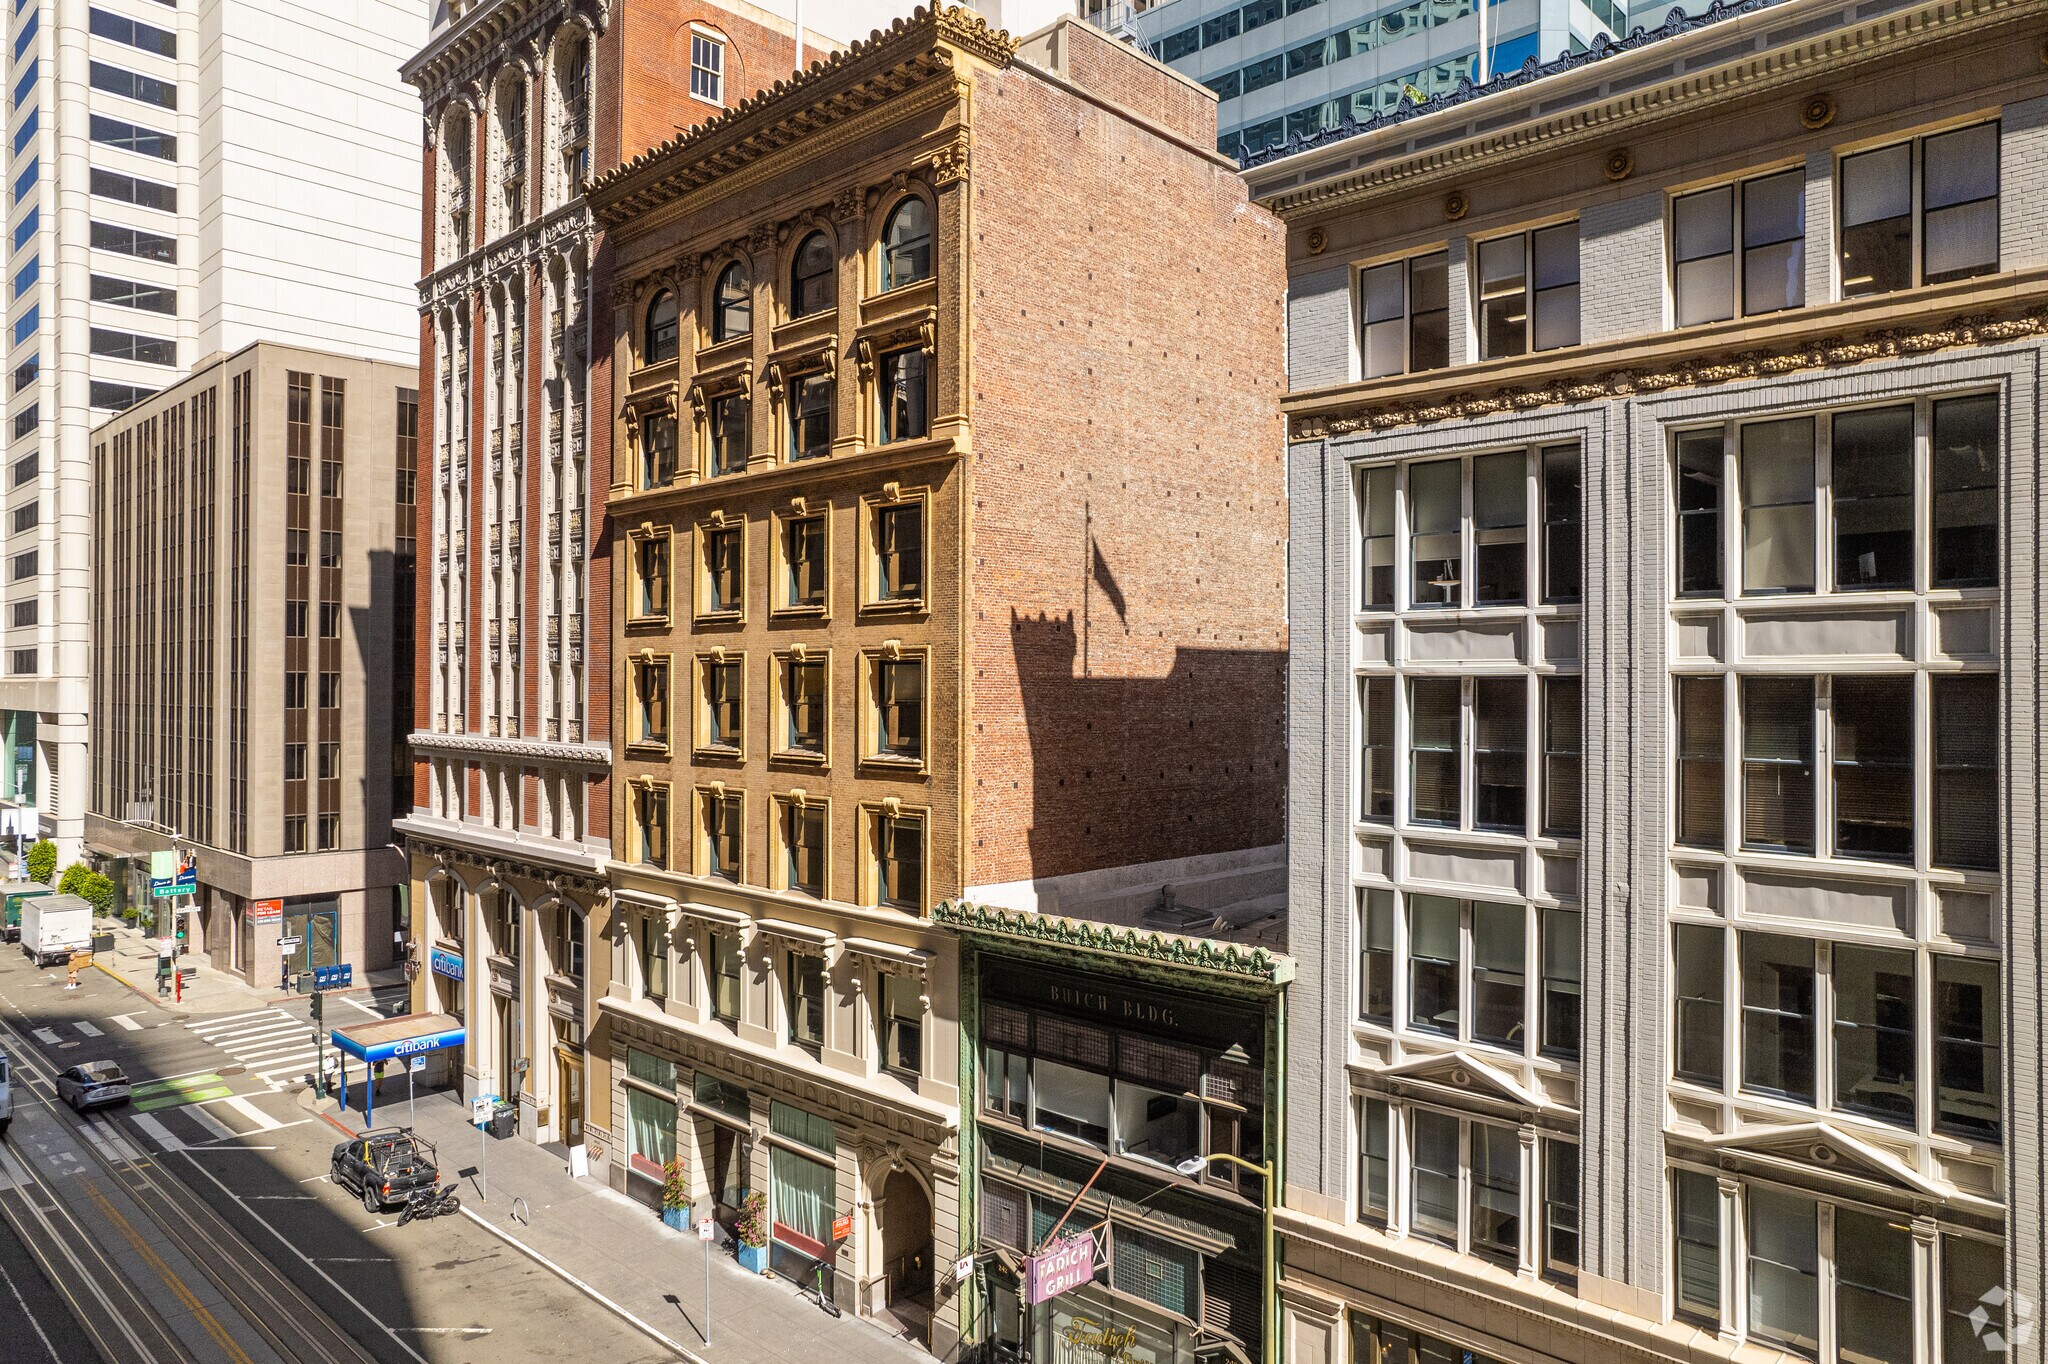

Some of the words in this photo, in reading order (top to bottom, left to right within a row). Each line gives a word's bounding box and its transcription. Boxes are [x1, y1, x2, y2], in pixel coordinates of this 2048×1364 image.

[159, 887, 190, 895] Battery
[434, 955, 464, 978] citibank
[1123, 1000, 1179, 1027] BLDG.
[393, 1037, 440, 1055] citibank
[1040, 1245, 1088, 1279] TADICH
[1045, 1269, 1083, 1296] GRILL
[1066, 1316, 1137, 1349] Tadich
